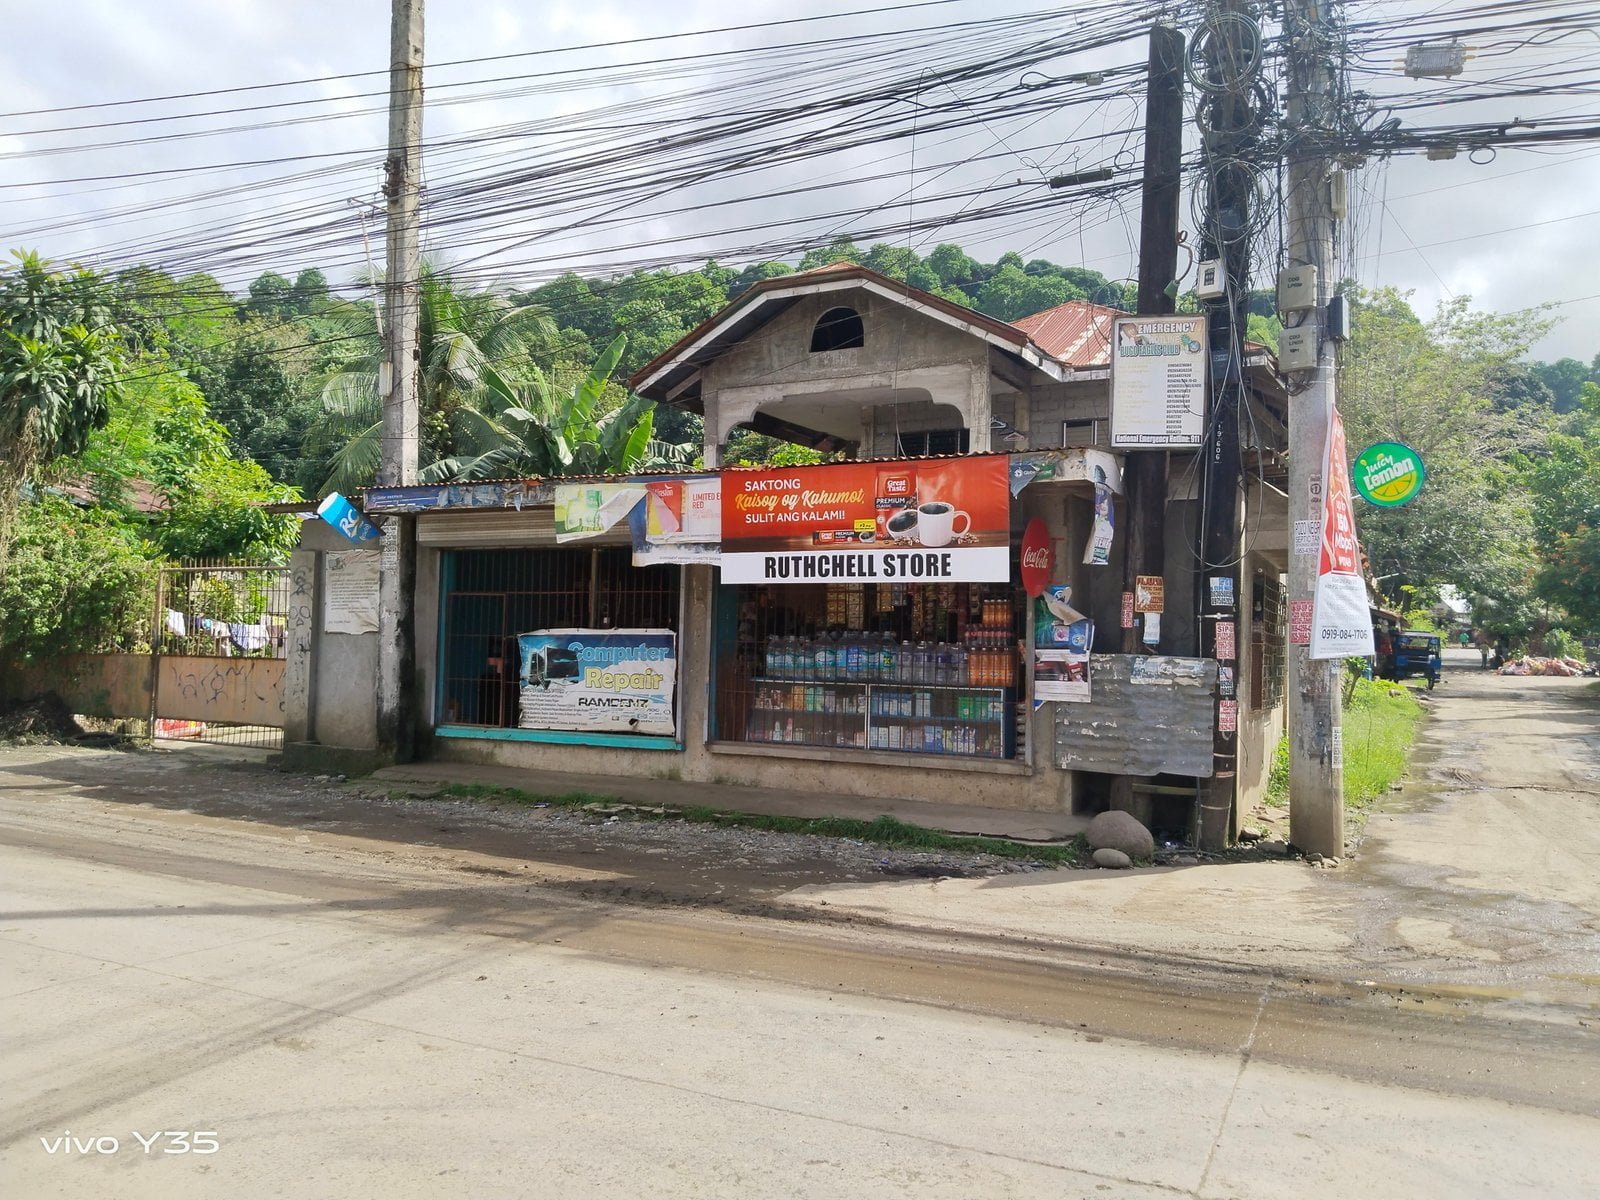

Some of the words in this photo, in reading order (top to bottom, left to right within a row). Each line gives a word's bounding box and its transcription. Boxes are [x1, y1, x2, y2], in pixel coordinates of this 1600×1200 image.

[1137, 322, 1196, 334] EMERGENCY
[1116, 434, 1138, 443] National
[1140, 434, 1169, 445] Emergency
[1191, 434, 1200, 443] 911
[1363, 458, 1415, 491] Lemon
[745, 478, 801, 492] SAKTONG
[692, 493, 715, 501] LIMITED
[735, 493, 780, 511] Kaisog
[781, 494, 800, 510] og
[692, 501, 704, 509] RED
[340, 508, 360, 538] RC
[745, 512, 775, 523] SULIT
[776, 511, 800, 522] ANG
[801, 510, 845, 521] KALAMI!
[764, 554, 877, 578] RUTHCHELL
[882, 553, 952, 577] STORE
[1321, 628, 1369, 640] 0919-084-1706
[568, 642, 670, 666] Computer
[584, 666, 663, 693] Repair
